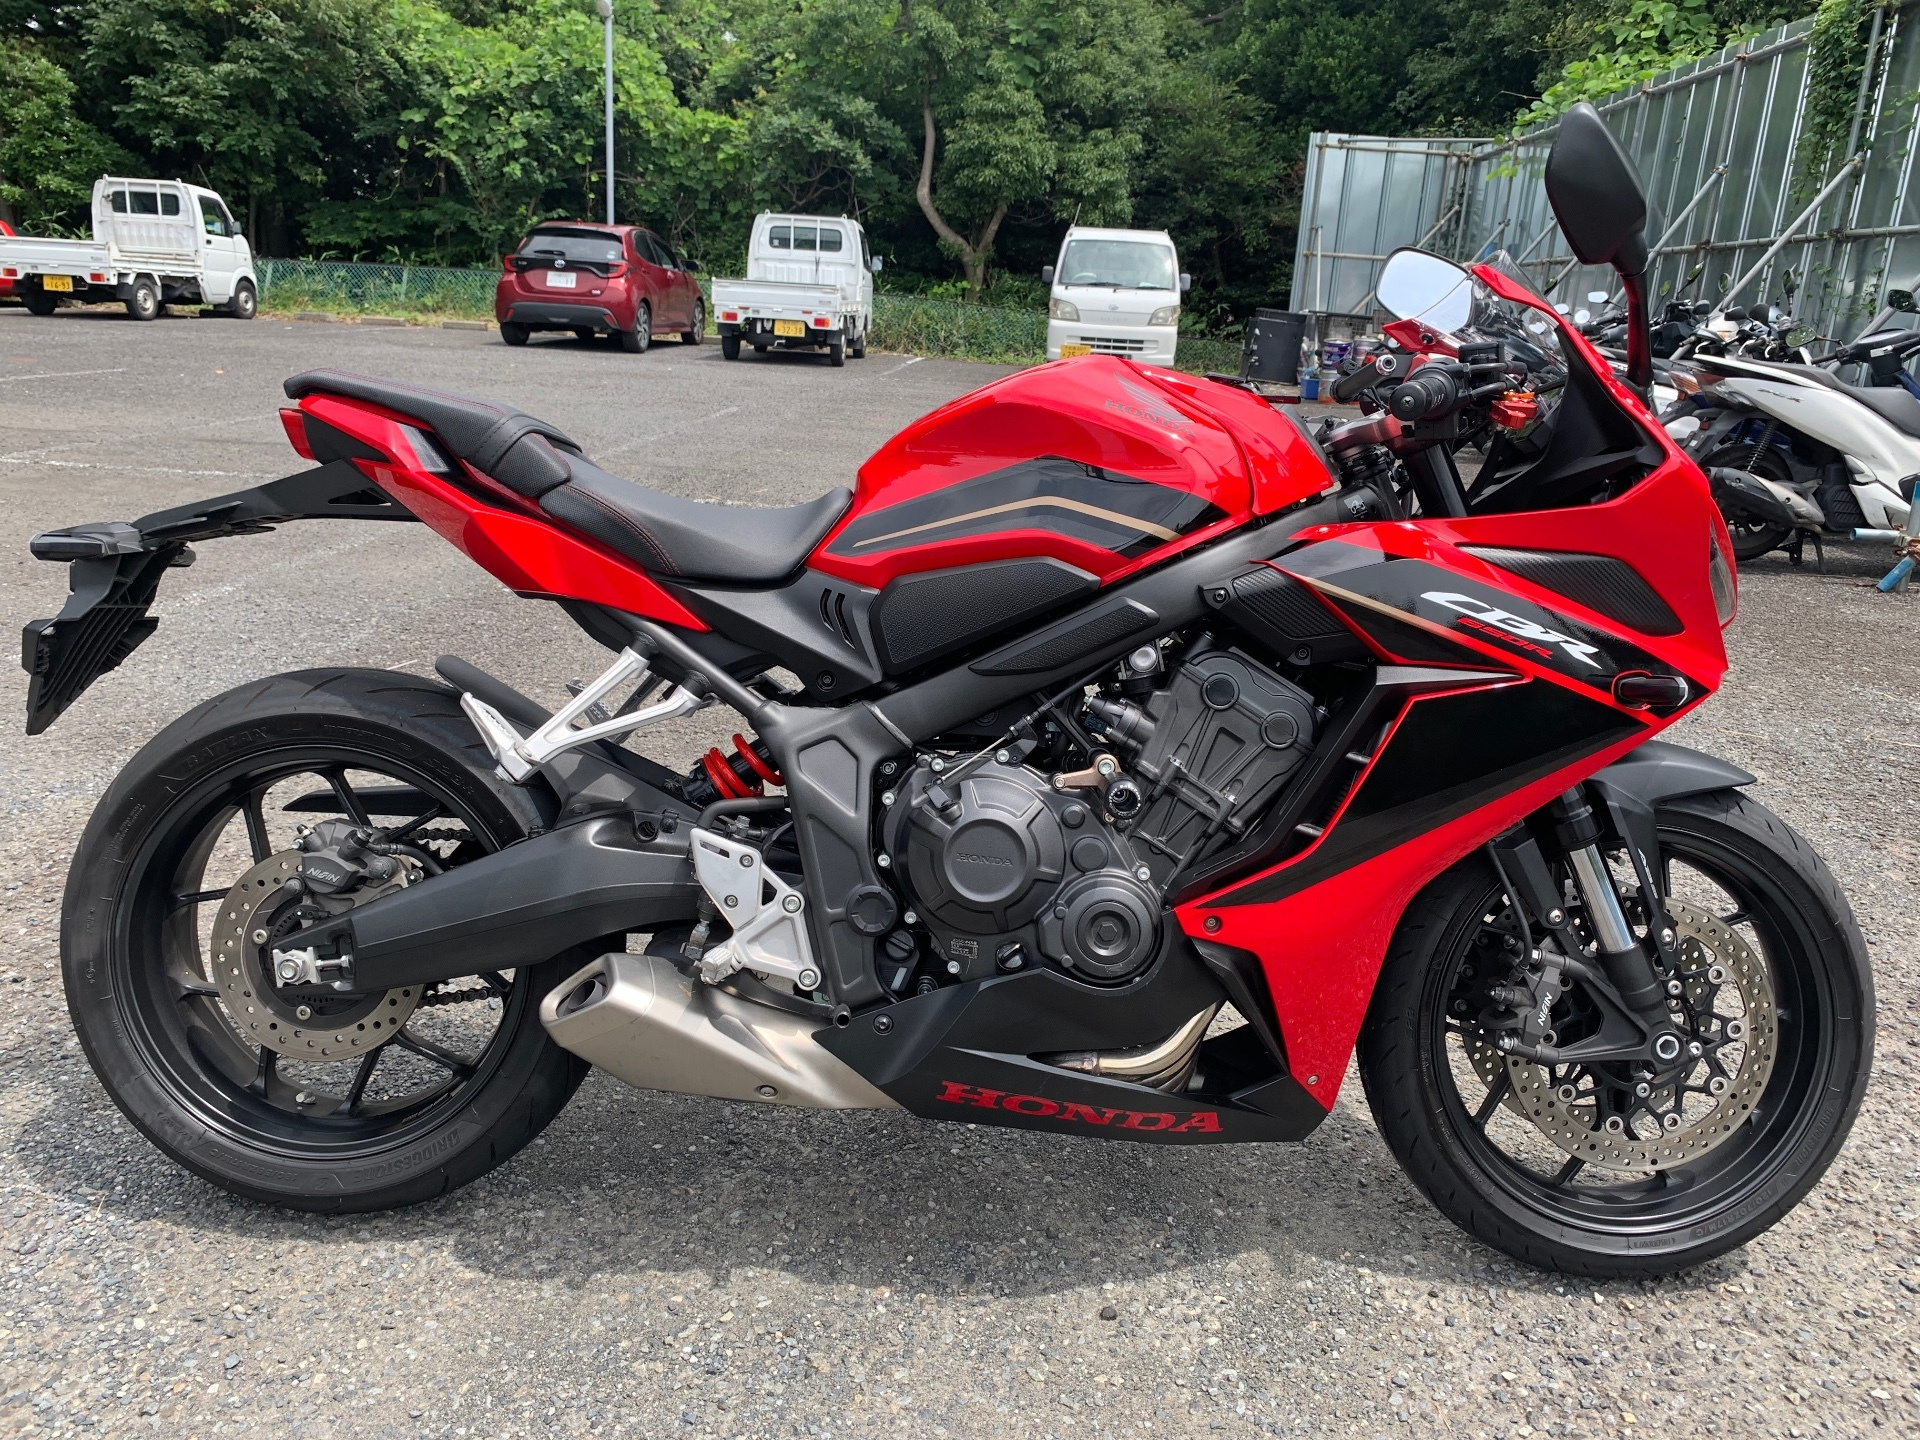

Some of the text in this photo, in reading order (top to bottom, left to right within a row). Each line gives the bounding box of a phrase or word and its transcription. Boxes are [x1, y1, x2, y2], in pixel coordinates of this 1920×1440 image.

[1105, 399, 1195, 438] HONDA
[1420, 591, 1603, 670] CBR
[1456, 617, 1554, 660] 650R
[956, 852, 1014, 867] HONDA
[935, 1080, 1224, 1133] HONDA
[353, 1127, 461, 1183] BRIDGESTONE
